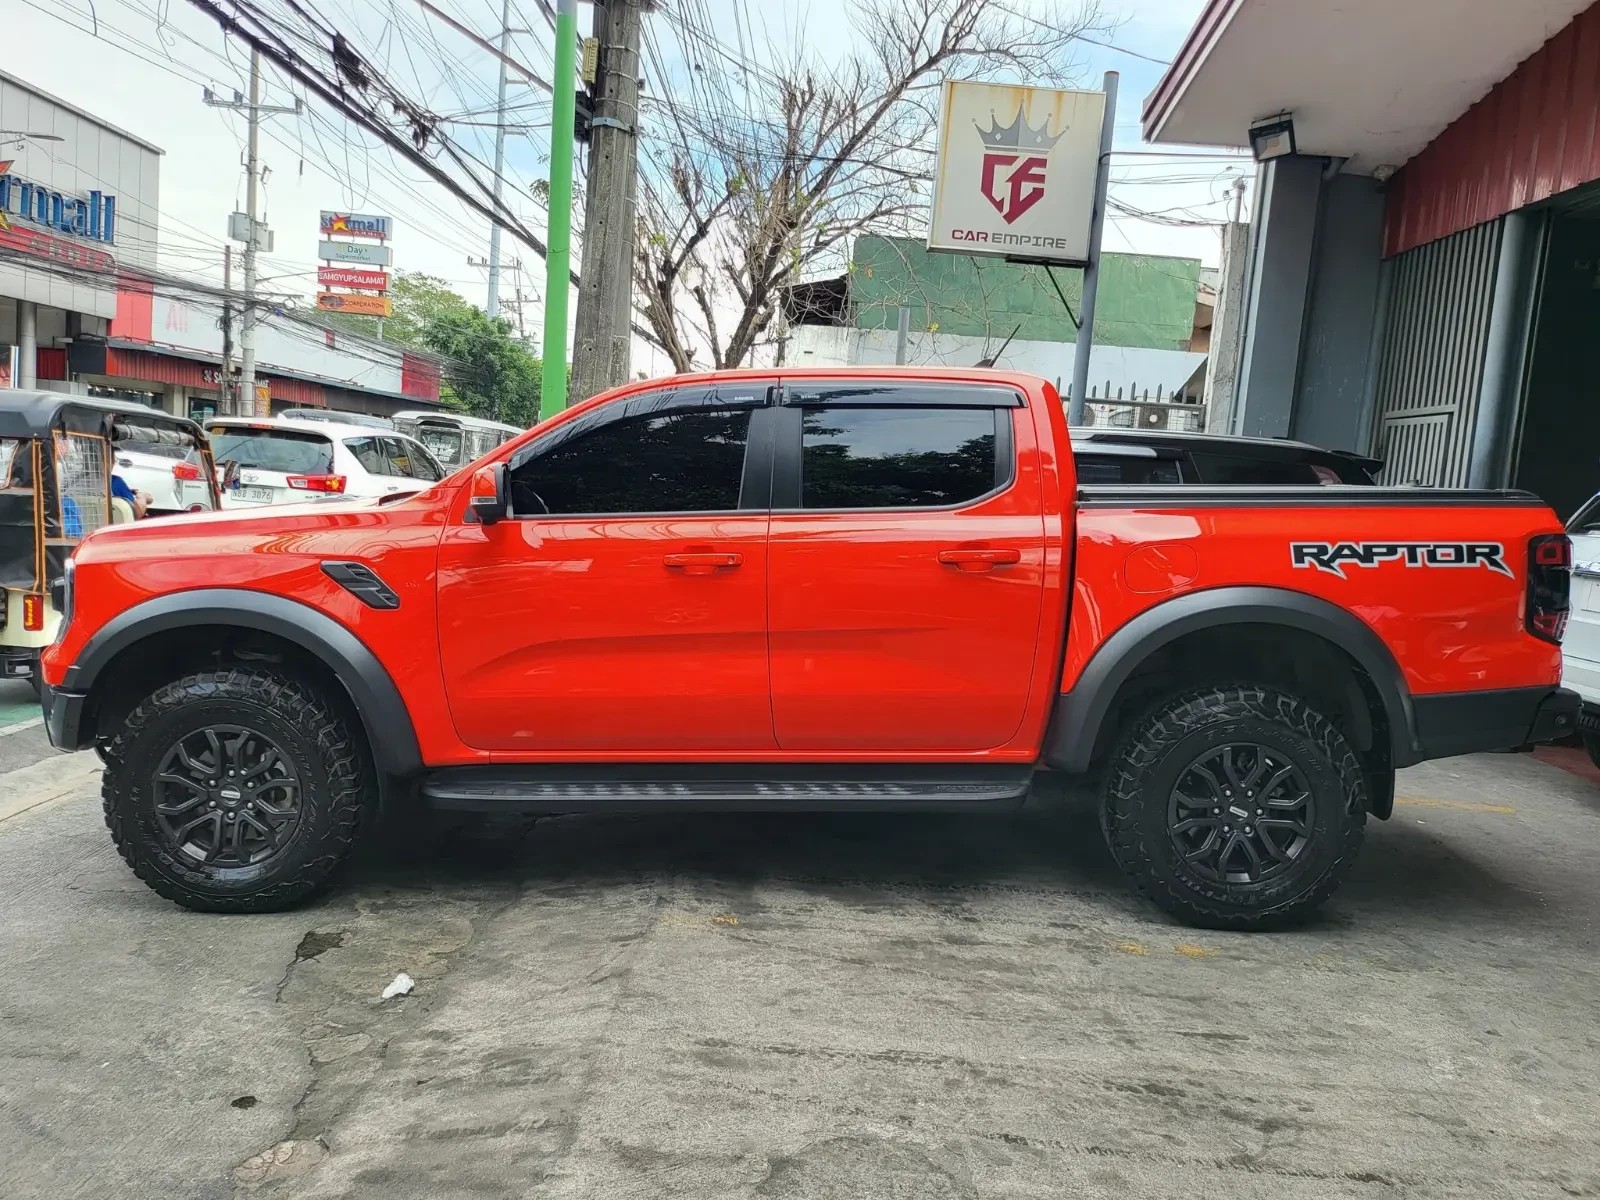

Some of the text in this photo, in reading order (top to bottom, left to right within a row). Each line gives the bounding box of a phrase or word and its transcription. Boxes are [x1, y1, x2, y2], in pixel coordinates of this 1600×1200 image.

[952, 230, 1066, 249] CAR EMPIRE
[347, 245, 363, 255] Day
[335, 253, 371, 261] Supermarket
[318, 273, 385, 285] SAMGYUPSALAMAT
[251, 490, 271, 500] 3076
[1289, 541, 1516, 581] RAPTOR
